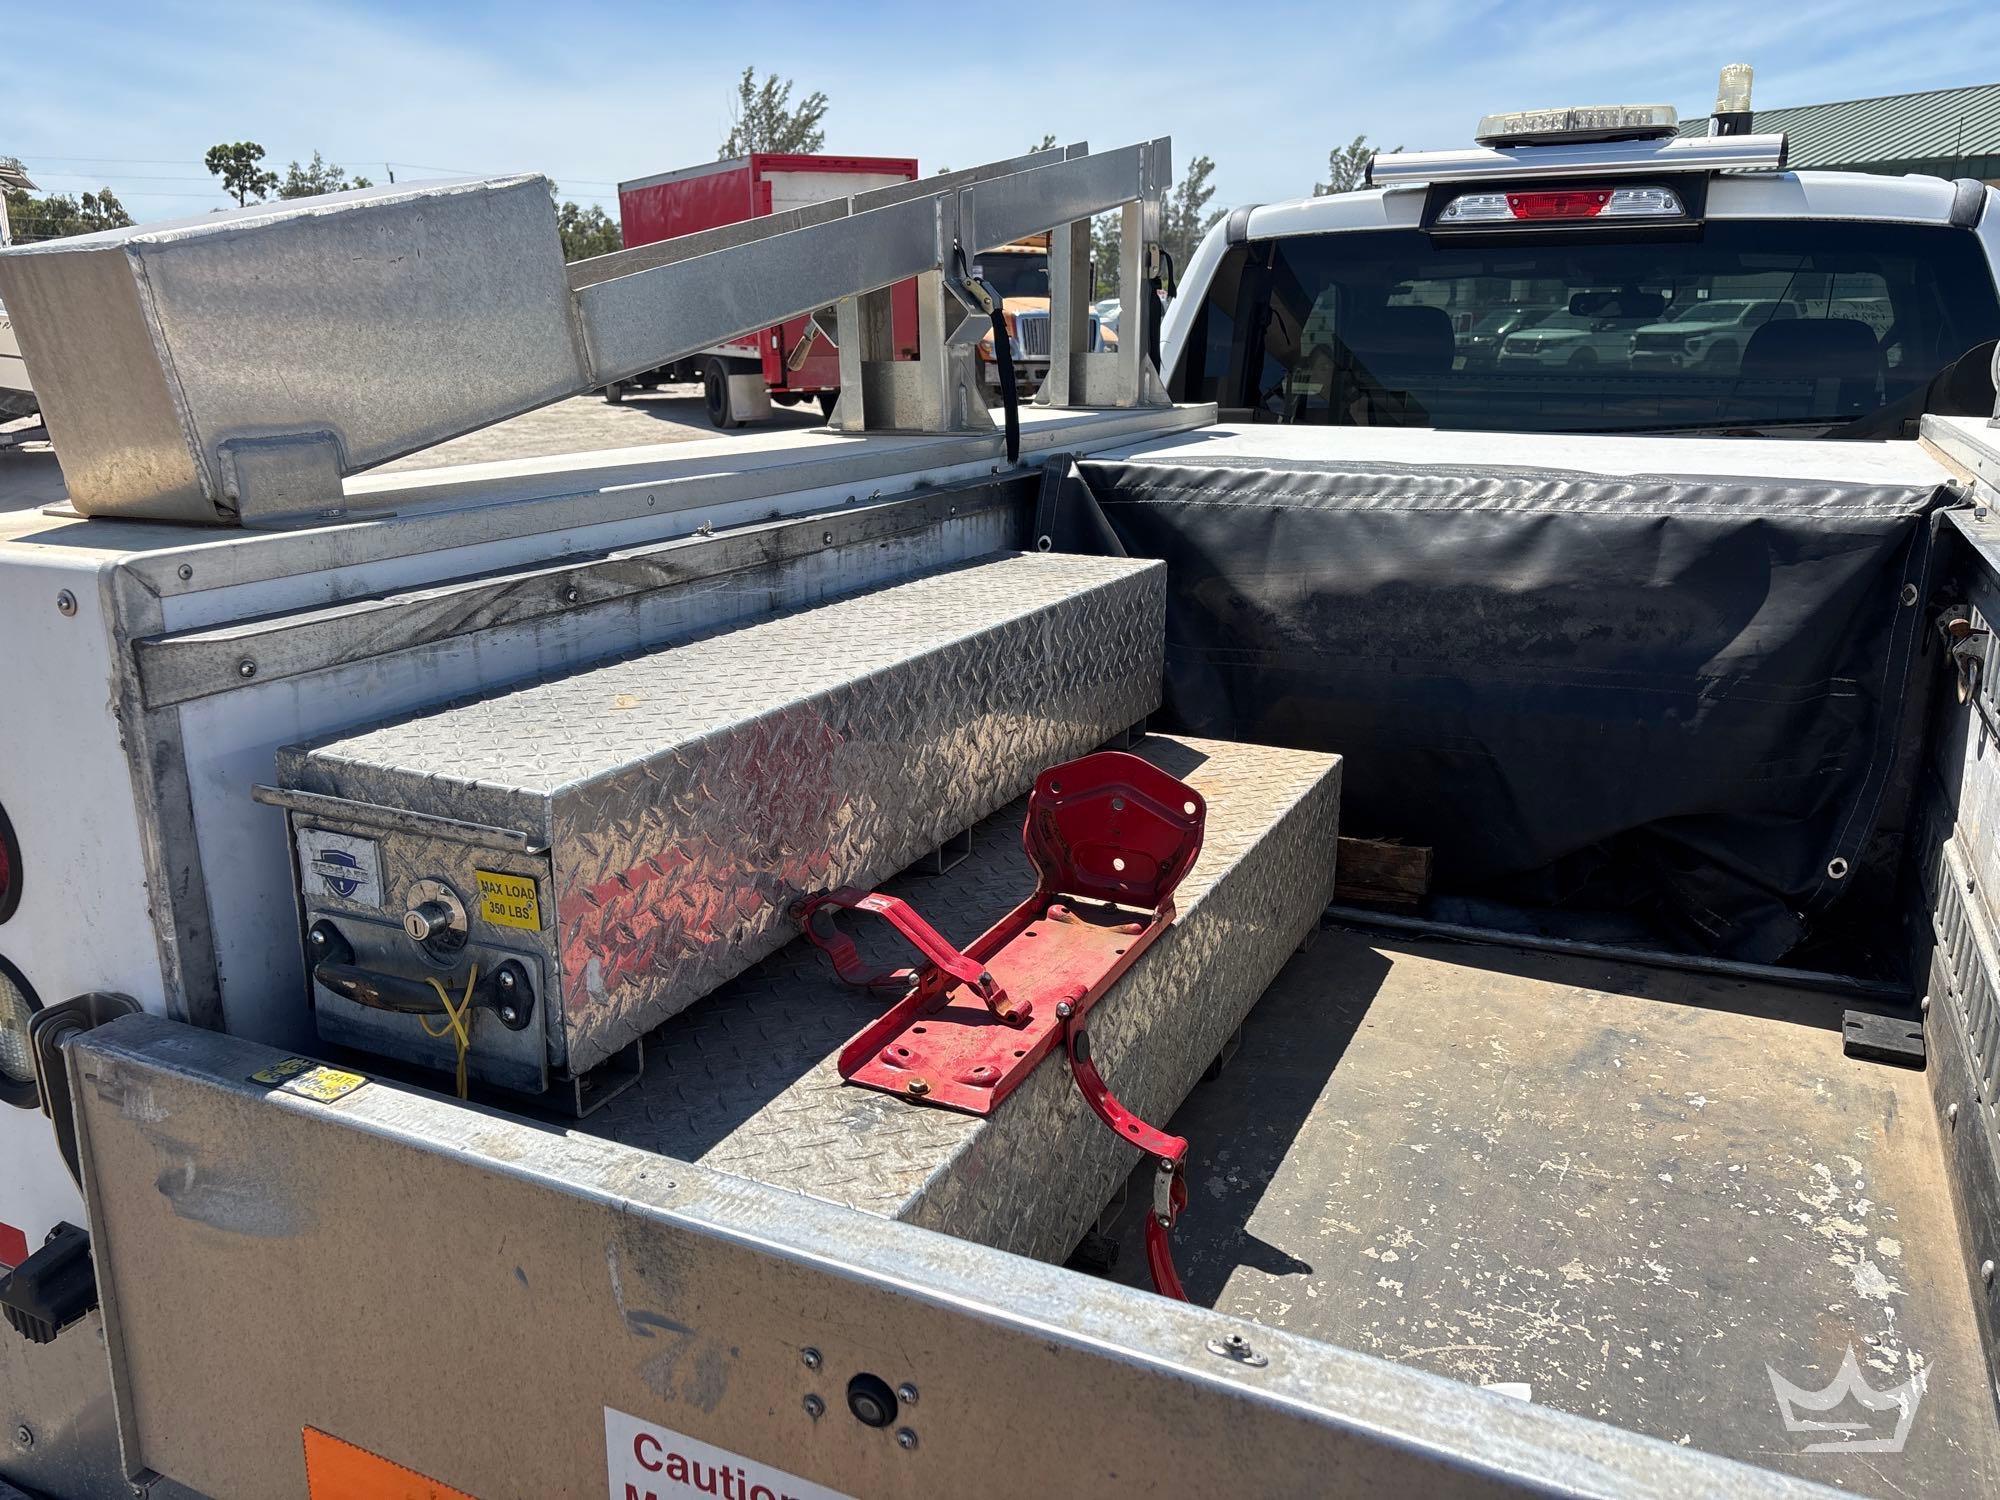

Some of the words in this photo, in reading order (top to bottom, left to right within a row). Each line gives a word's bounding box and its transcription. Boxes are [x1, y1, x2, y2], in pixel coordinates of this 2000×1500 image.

[480, 880, 503, 895] MAX
[505, 885, 535, 900] LOAD
[489, 902, 505, 916] 350
[508, 905, 533, 920] LBS.
[325, 1073, 359, 1086] GATE
